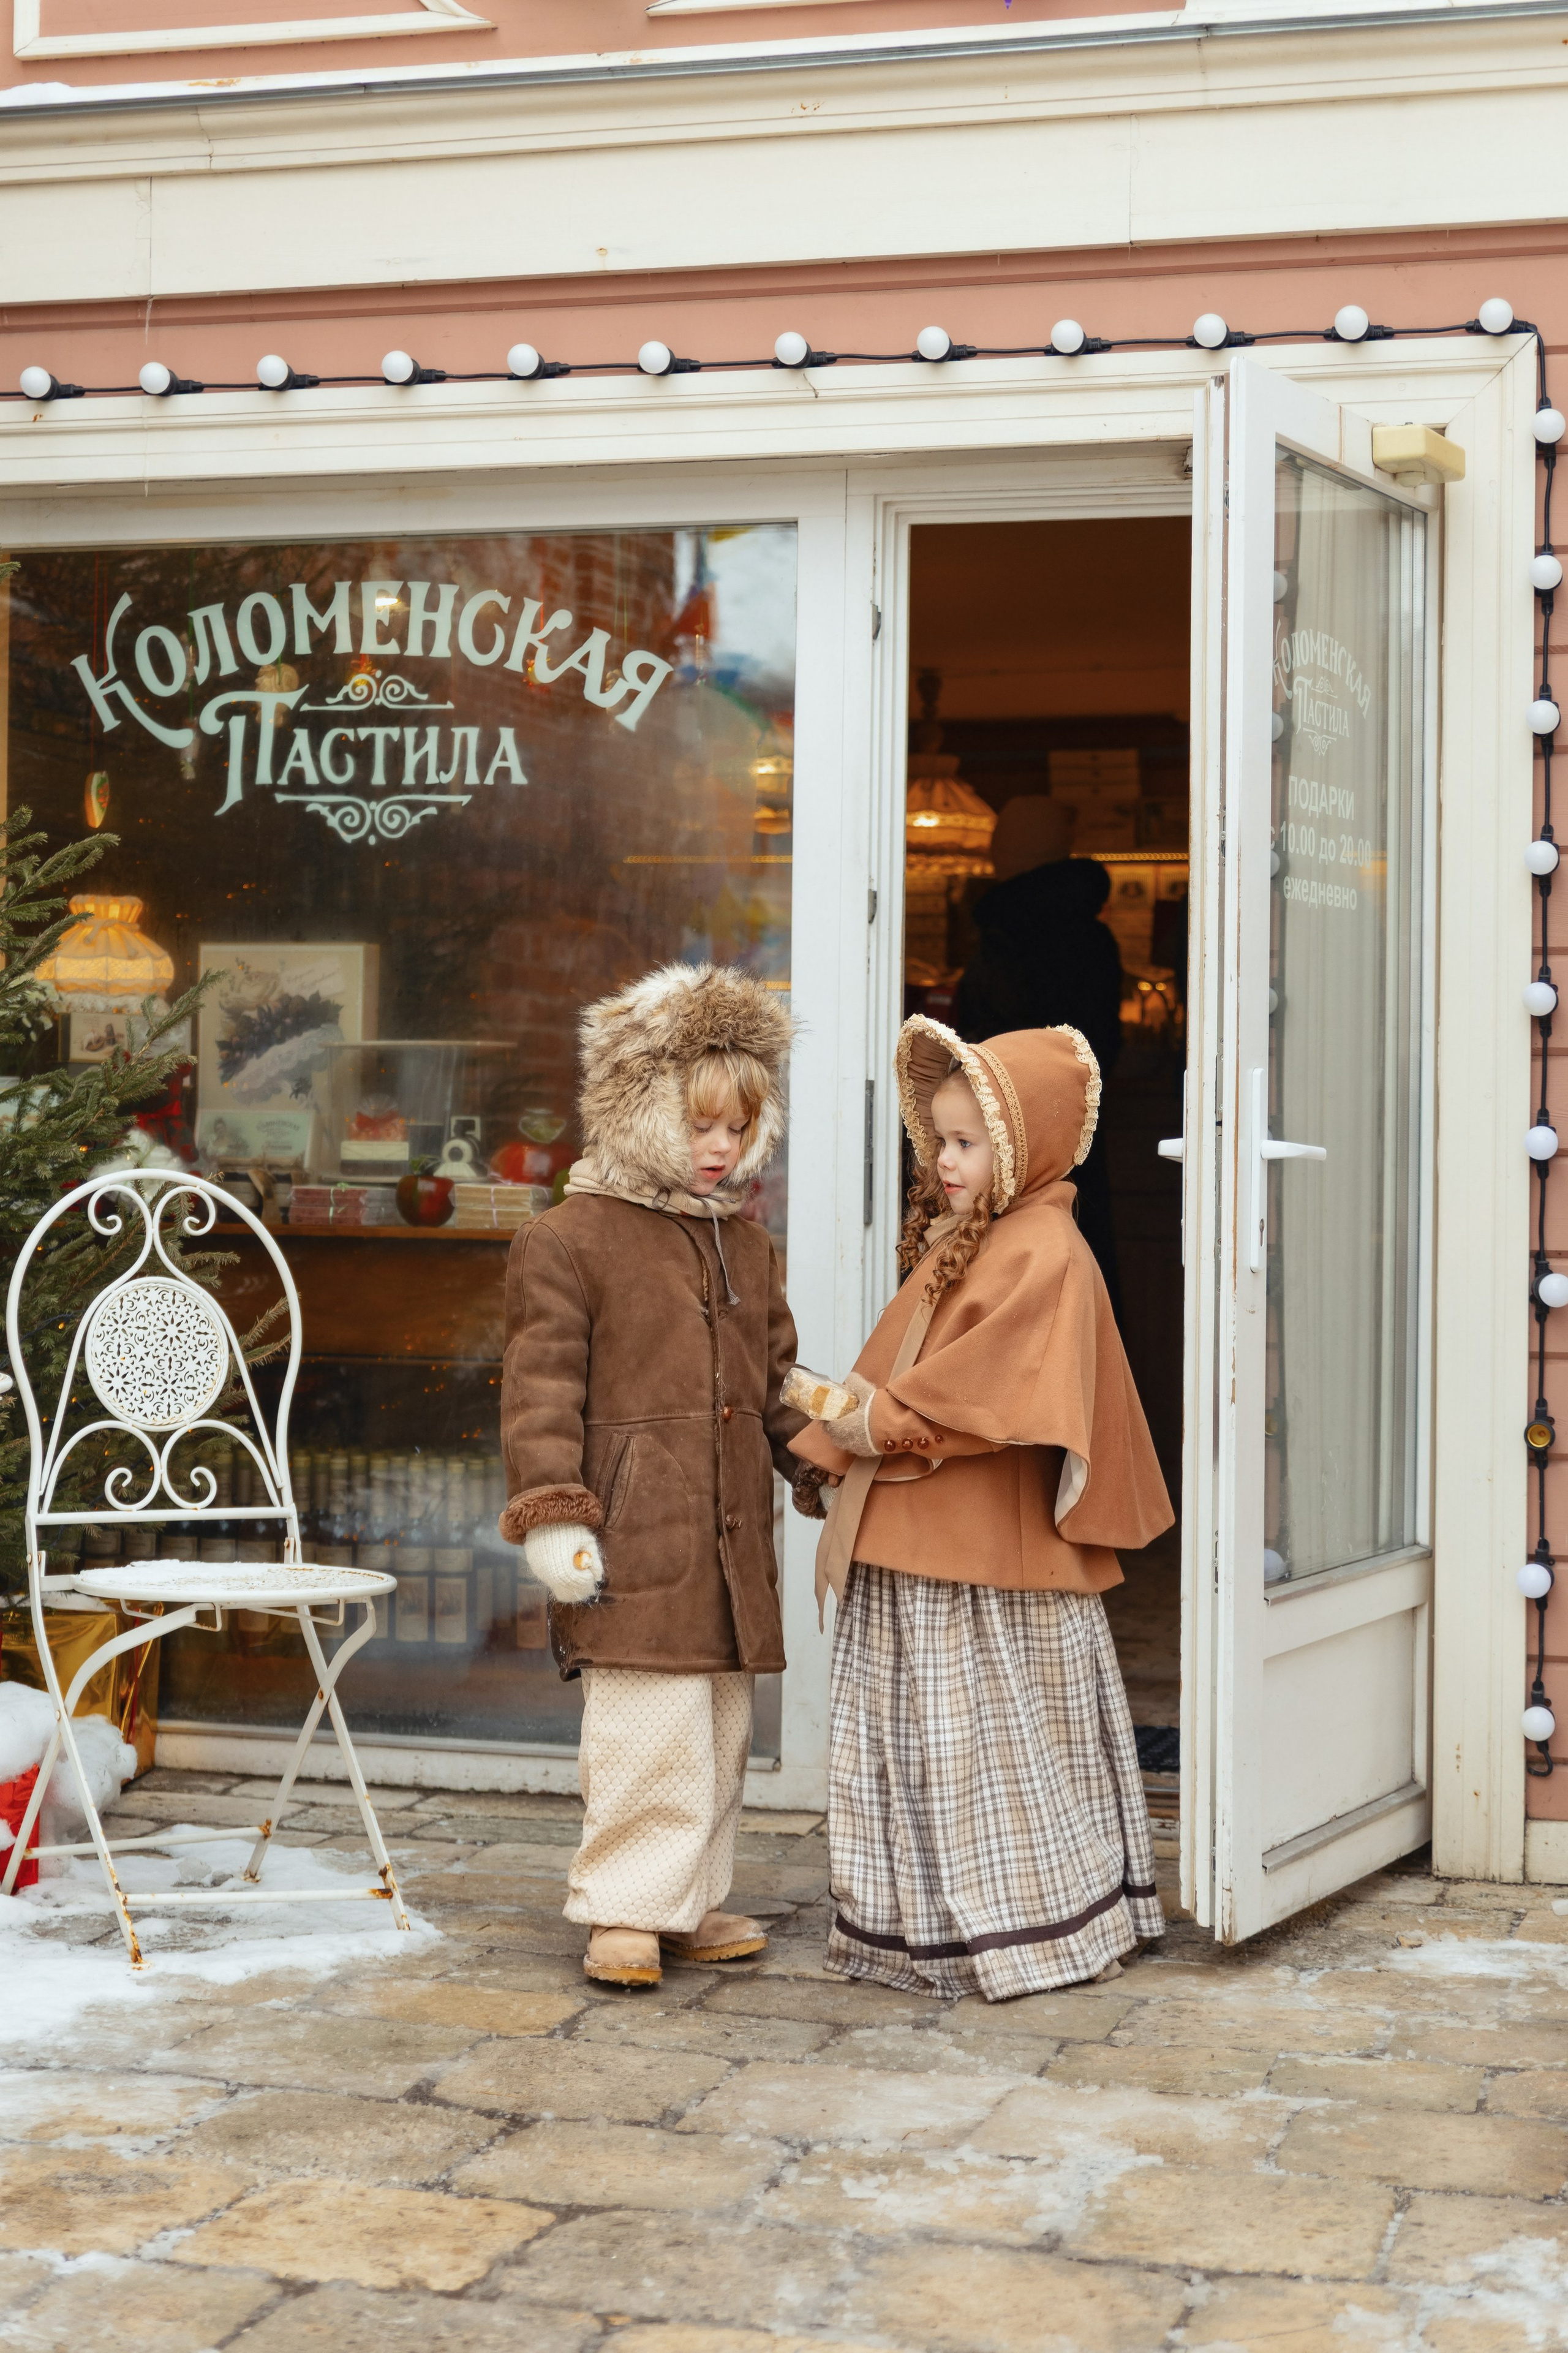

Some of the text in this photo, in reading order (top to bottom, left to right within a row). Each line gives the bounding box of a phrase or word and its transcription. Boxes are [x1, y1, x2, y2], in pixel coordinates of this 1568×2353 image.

[71, 580, 674, 749] КОЛОМЕНСКАЯ
[1273, 619, 1371, 719] КОЛОМЕНСКАЯ
[1294, 676, 1349, 737] ПАСТИЛА
[200, 684, 528, 816] ПАСТИЛА
[1289, 776, 1354, 820] ПОДАРКИ
[1280, 820, 1315, 857] 10.00
[1319, 837, 1336, 865] до
[1340, 834, 1371, 868] 20.00
[1283, 876, 1357, 910] ежедневно
